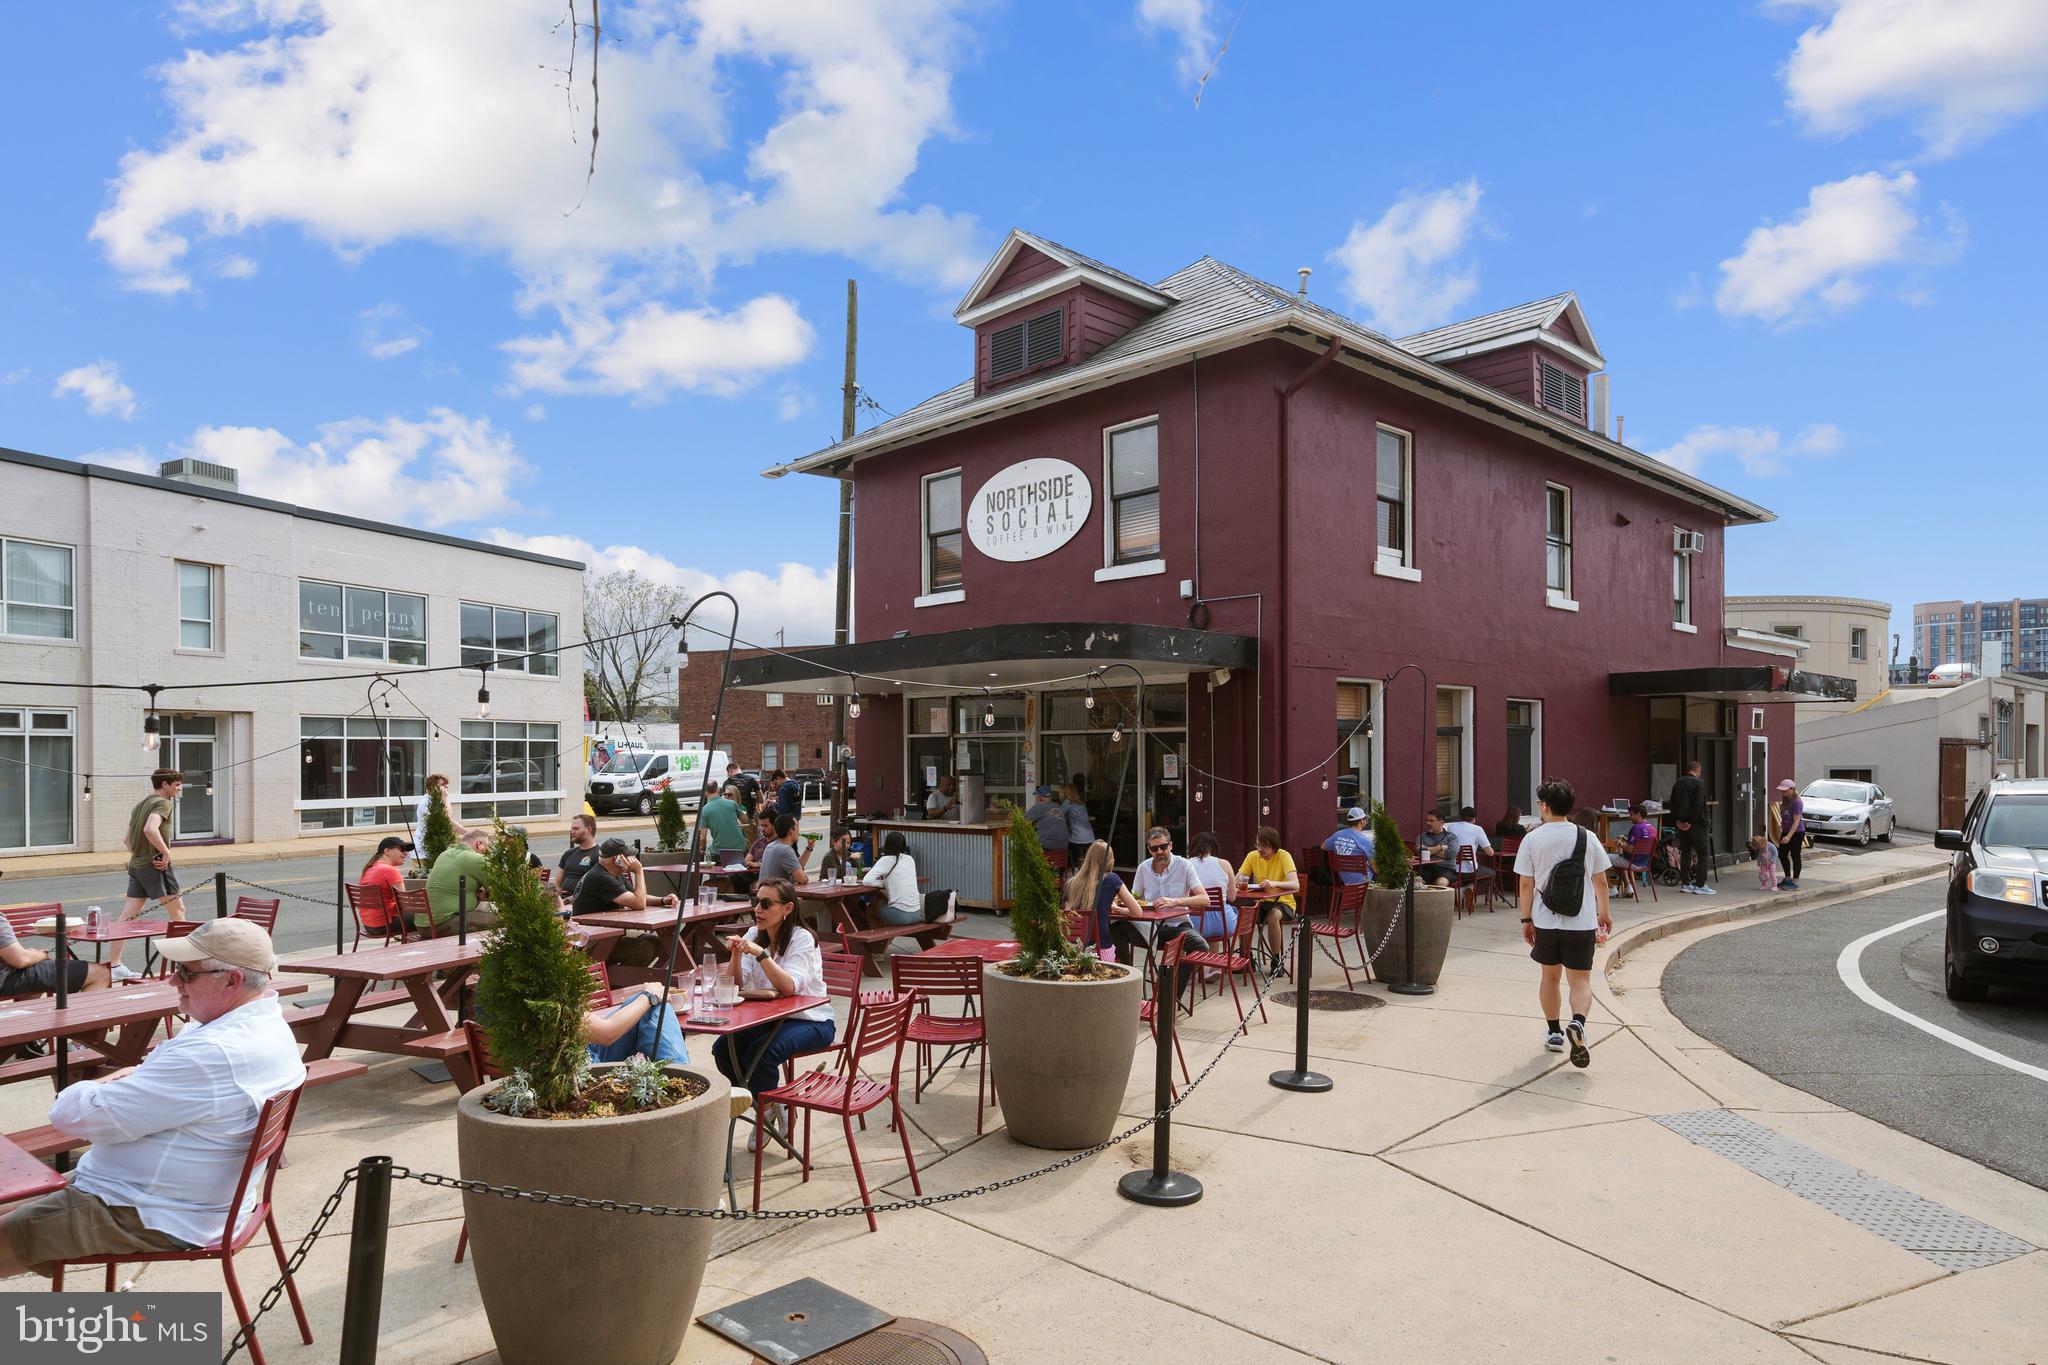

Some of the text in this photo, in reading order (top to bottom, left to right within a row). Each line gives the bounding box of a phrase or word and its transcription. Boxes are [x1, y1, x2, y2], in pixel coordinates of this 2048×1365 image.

[986, 474, 1074, 514] NORTHSIDE
[986, 498, 1074, 535] SOCIAL
[986, 520, 1074, 547] COFFEE & WINE
[309, 600, 416, 628] ten penny
